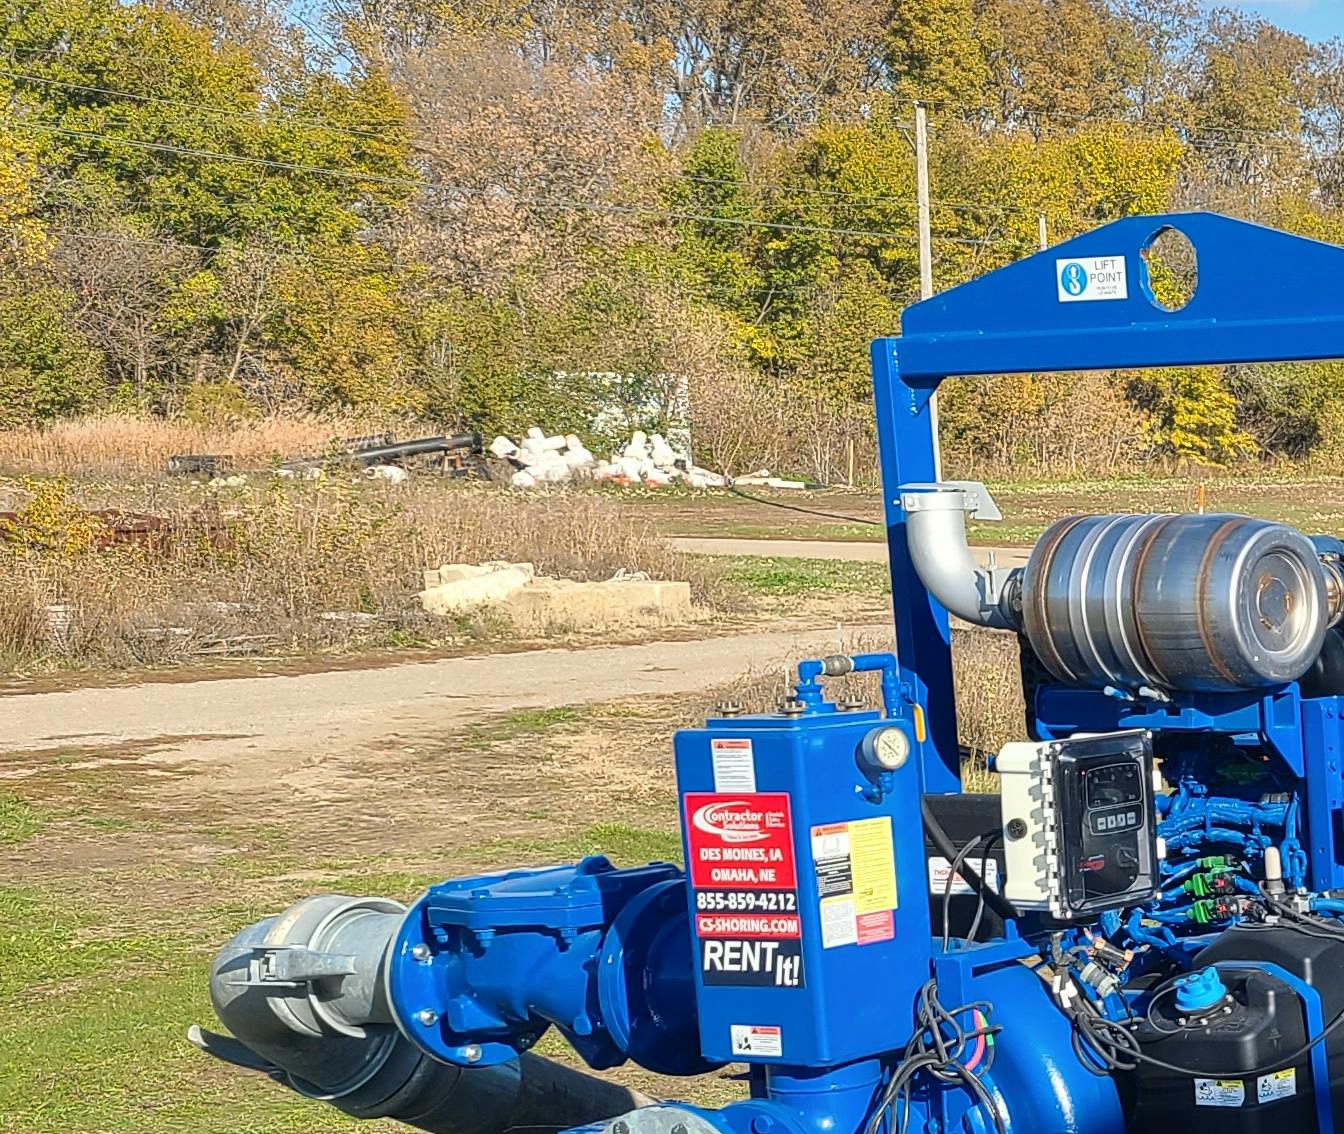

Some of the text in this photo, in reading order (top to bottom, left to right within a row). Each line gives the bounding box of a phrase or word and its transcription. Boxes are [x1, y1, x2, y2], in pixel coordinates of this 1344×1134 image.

[1094, 259, 1117, 271] LIFT
[1089, 271, 1123, 284] POINT
[700, 804, 764, 829] Contractor
[699, 847, 784, 863] DES MOINES, IA
[711, 868, 777, 884] OMAHA, NE
[696, 892, 796, 911] 855-859-4212
[699, 918, 799, 933] CS-SHORING.COM
[703, 940, 801, 986] RENT It!
